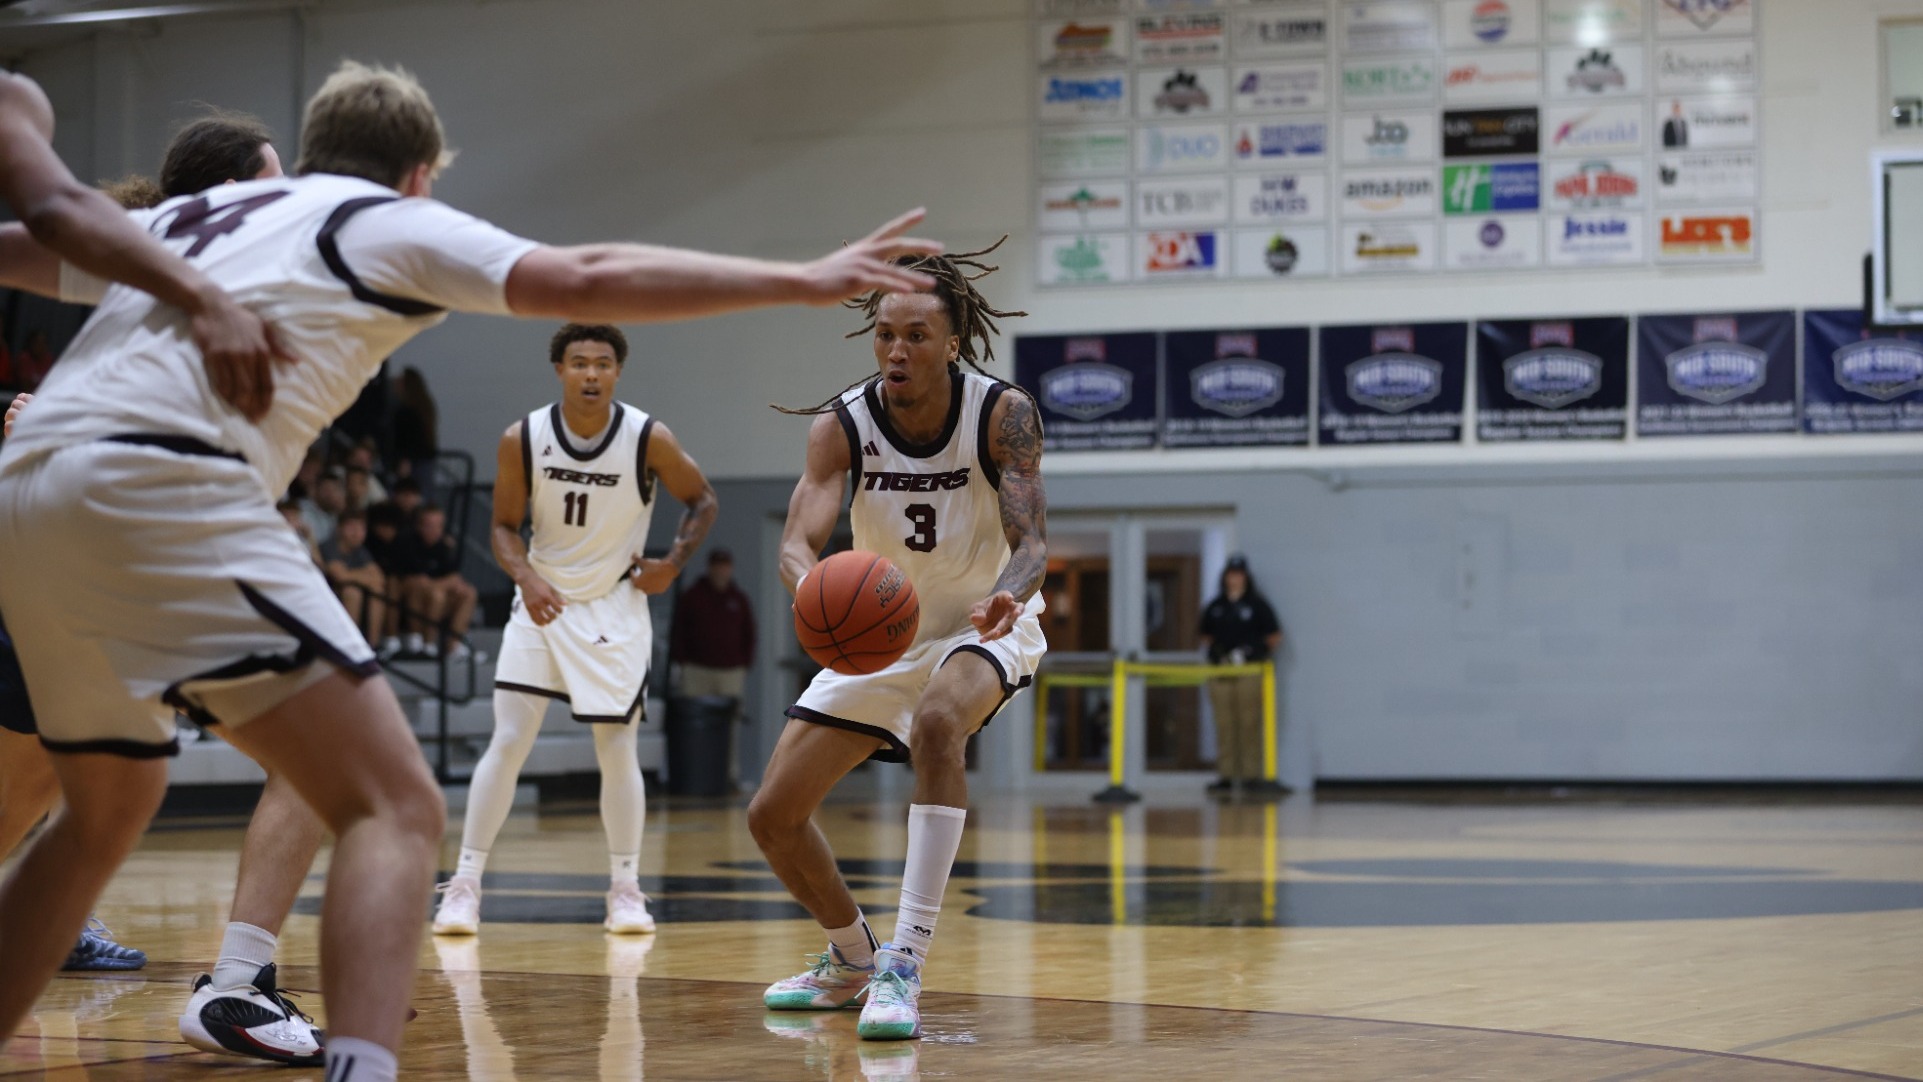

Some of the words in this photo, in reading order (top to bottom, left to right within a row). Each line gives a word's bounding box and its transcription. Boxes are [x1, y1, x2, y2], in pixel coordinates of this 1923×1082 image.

[543, 467, 621, 486] TIGERS
[864, 468, 970, 492] TIGERS
[564, 491, 588, 527] 11
[904, 503, 937, 552] 3
